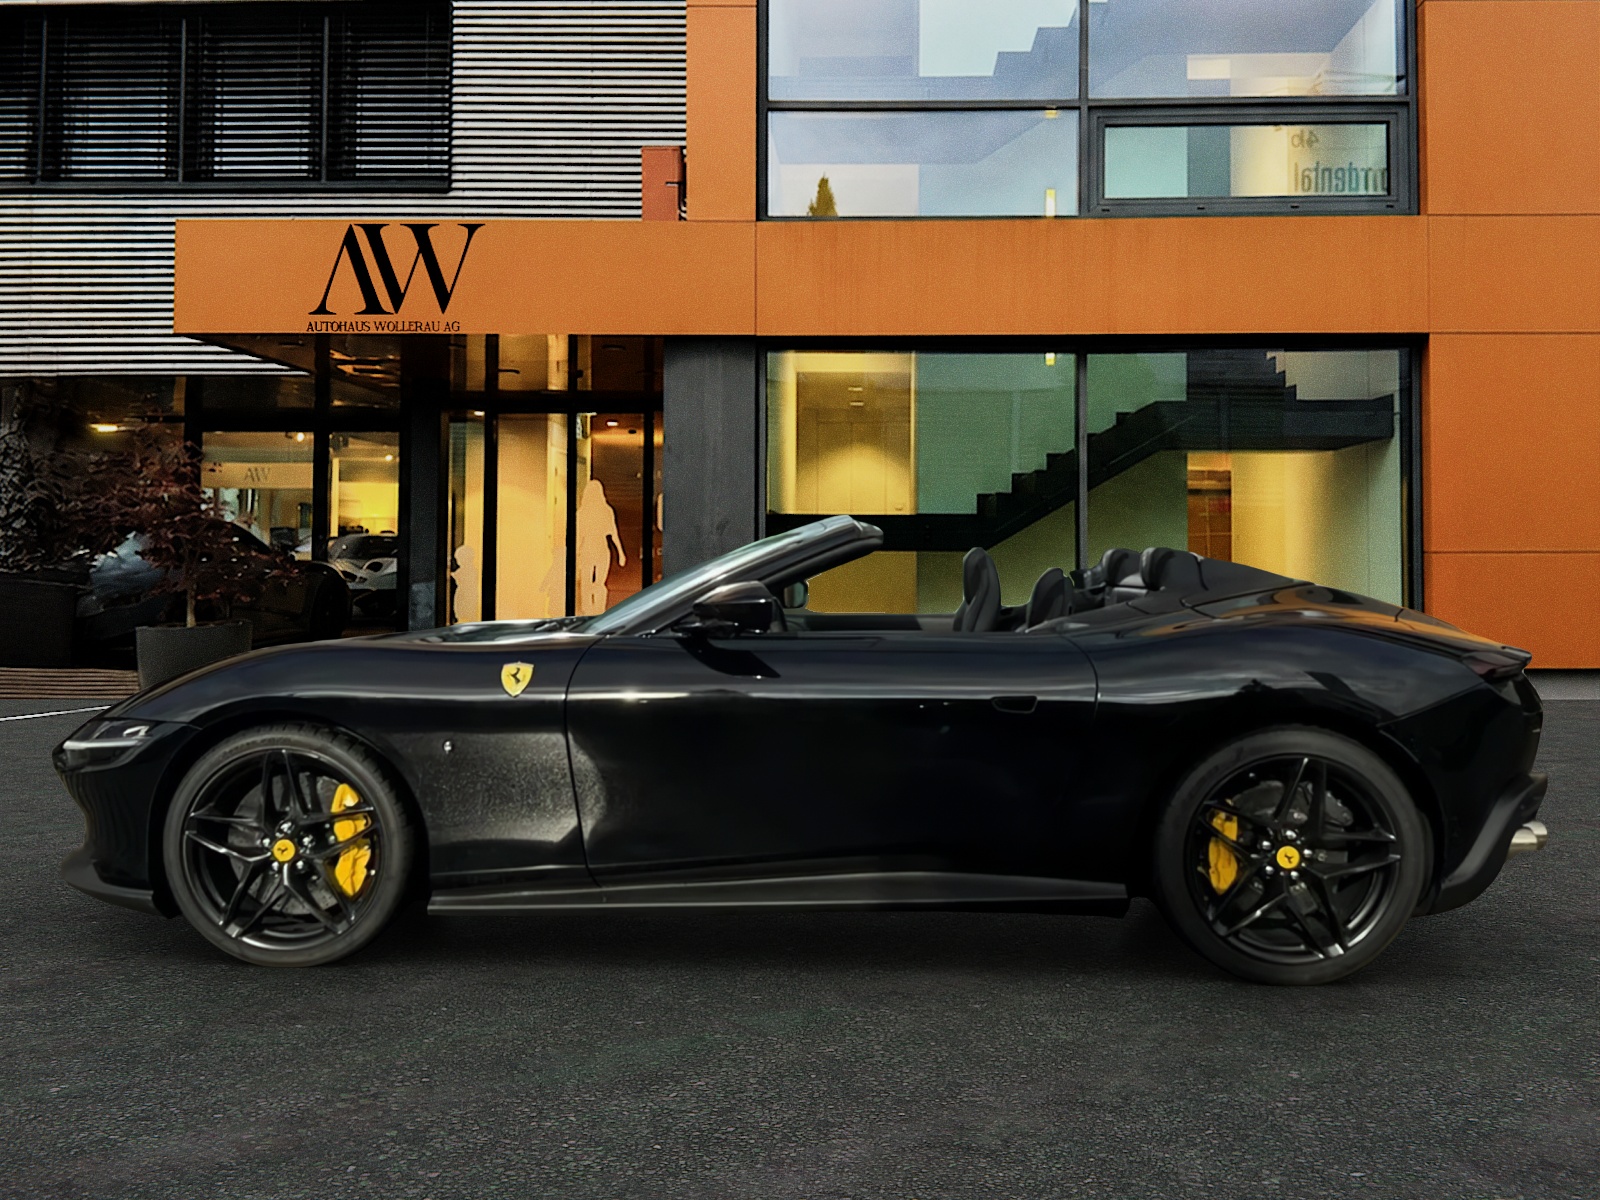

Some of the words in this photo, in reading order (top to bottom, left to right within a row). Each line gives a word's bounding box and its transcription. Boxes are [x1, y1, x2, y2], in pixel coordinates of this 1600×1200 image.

[308, 223, 486, 315] AW
[306, 321, 371, 332] AUTOHAUS
[373, 321, 441, 332] WOLLERAU
[443, 321, 461, 332] AG
